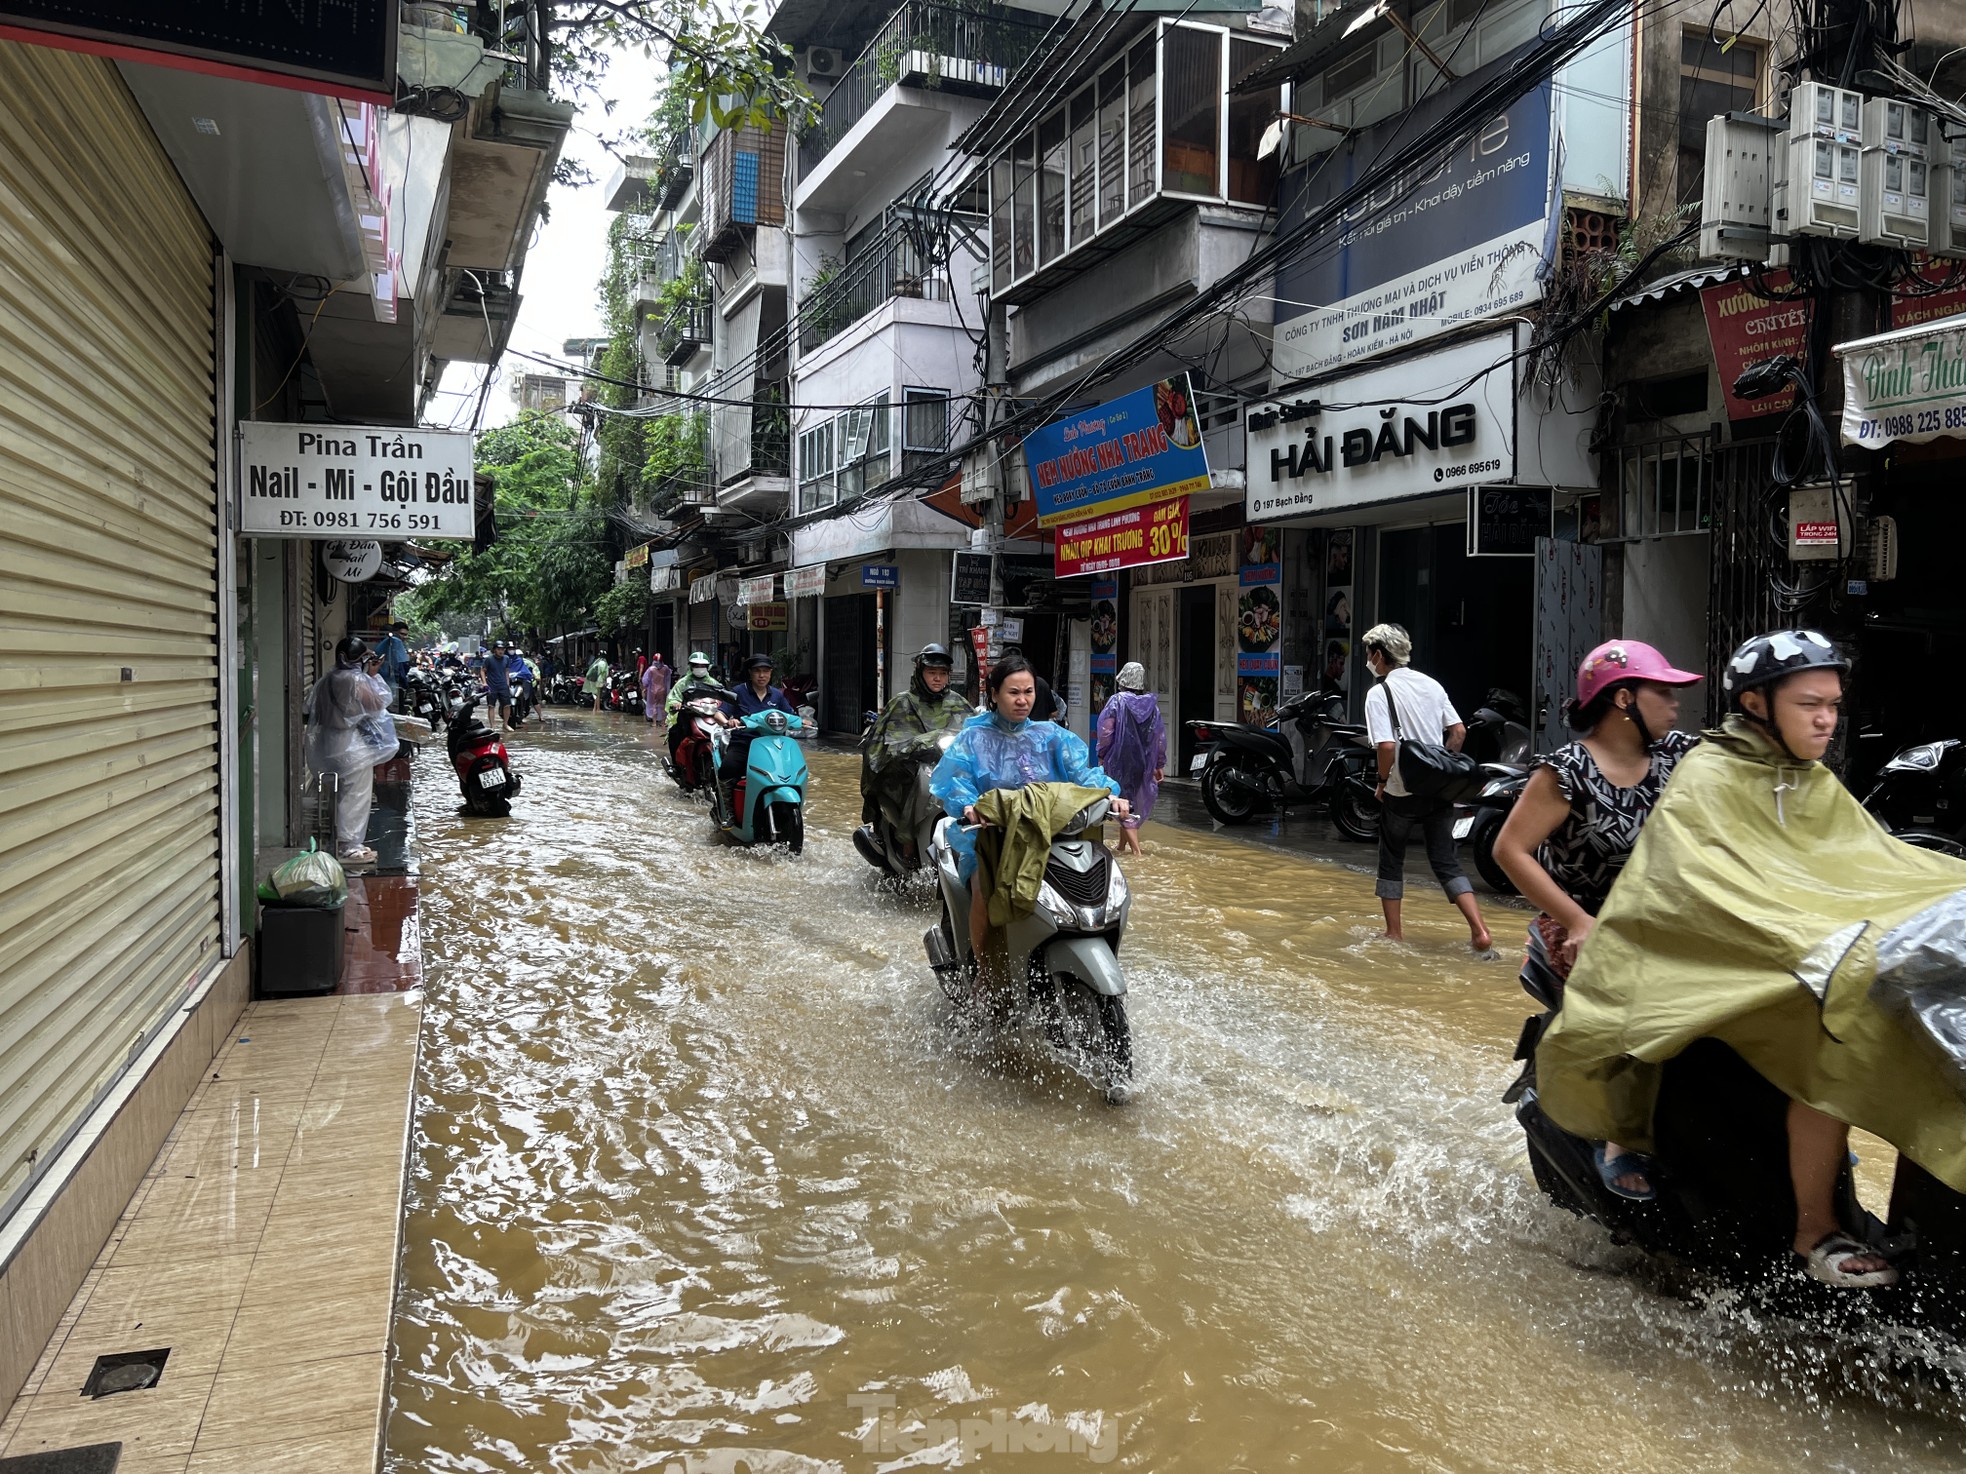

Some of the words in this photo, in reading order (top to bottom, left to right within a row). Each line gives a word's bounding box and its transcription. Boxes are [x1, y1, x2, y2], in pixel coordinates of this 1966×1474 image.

[1443, 183, 1464, 200] dậy
[1467, 170, 1494, 190] tiềm
[1497, 152, 1530, 176] năng
[1285, 324, 1308, 341] CÔNG
[1310, 320, 1320, 332] TY
[1322, 311, 1344, 328] TNHH
[1385, 289, 1401, 306] MẠI
[1403, 282, 1415, 297] VÀ
[1419, 273, 1441, 292] DỊCH
[1444, 267, 1458, 282] VỤ
[1460, 254, 1484, 275] VIỄN
[1441, 310, 1472, 327] MOBILE:
[1474, 304, 1492, 316] 0934
[1494, 297, 1507, 309] 695
[1509, 290, 1523, 303] 689
[1342, 319, 1369, 343] SƠN
[1373, 306, 1405, 332] NAM
[1409, 291, 1447, 320] NHẬT
[1897, 309, 1931, 324] VÁCH
[1347, 346, 1366, 360] HOÀN
[1367, 338, 1384, 353] KIẾM
[1389, 334, 1399, 346] HÀ
[1401, 328, 1413, 342] NỘI
[1739, 342, 1769, 356] NHÔM
[1771, 336, 1799, 349] KÍNH:
[1859, 419, 1881, 438] ĐT:
[1885, 414, 1914, 437] 0988
[1918, 410, 1940, 433] 225
[298, 432, 356, 456] Pina
[366, 434, 422, 459] Trần
[1036, 459, 1059, 489] NEM
[1058, 445, 1098, 482] NƯỚNG
[1096, 438, 1124, 472] NHA
[1124, 422, 1169, 464] TRANG
[1270, 426, 1333, 482] HẢI
[1341, 403, 1476, 468] ĐĂNG
[1446, 465, 1466, 478] 0966
[250, 465, 298, 498] Nail
[325, 469, 354, 500] Mi
[380, 470, 417, 509] Gội
[425, 467, 469, 504] Đầu
[1263, 499, 1274, 509] 197
[1276, 496, 1293, 508] Bạch
[1294, 492, 1313, 505] Đằng
[1483, 491, 1519, 514] Tóc
[280, 510, 307, 526] ĐT:
[313, 512, 359, 528] 0981
[367, 513, 401, 528] 756
[408, 514, 441, 529] 591
[1481, 515, 1509, 545] HẢI
[1094, 536, 1111, 556] KHAI
[1113, 528, 1143, 552] TRƯƠNG
[1150, 520, 1187, 557] 30%
